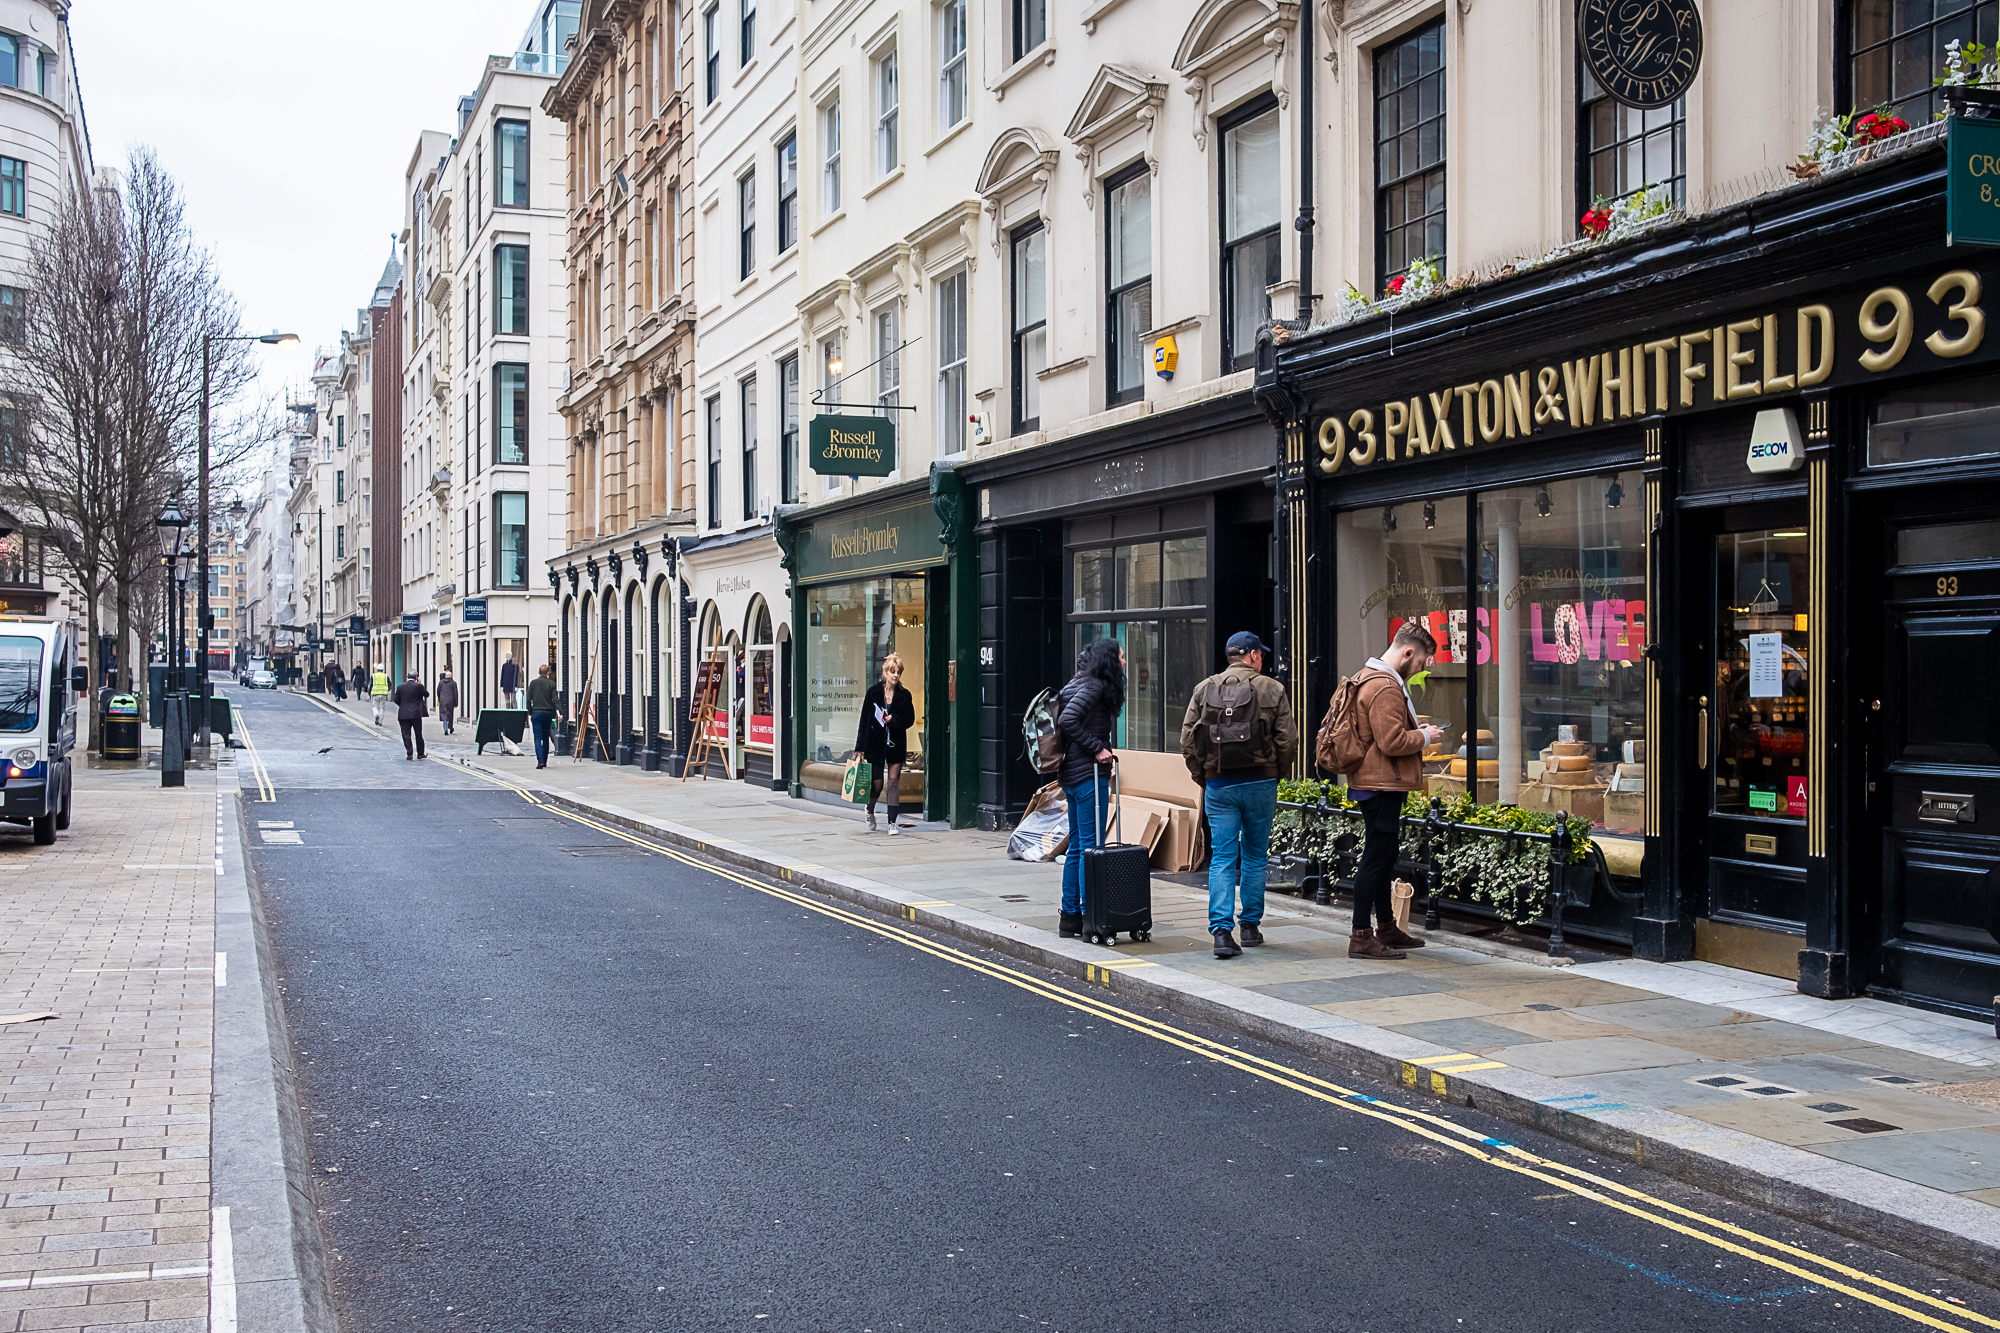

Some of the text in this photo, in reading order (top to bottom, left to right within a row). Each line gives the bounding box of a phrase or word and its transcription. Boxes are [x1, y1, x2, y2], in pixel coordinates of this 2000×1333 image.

[1588, 25, 1694, 101] WHITFIELD
[1968, 154, 2000, 177] CR
[1318, 408, 1377, 473] 93
[1858, 269, 1986, 373] 93
[829, 428, 875, 445] Russell
[1752, 442, 1787, 458] SECOM
[1504, 568, 1619, 611] CHEESEMONGERS
[1936, 576, 1958, 595] 93
[981, 647, 993, 665] 94
[1938, 802, 1958, 810] LETTERS
